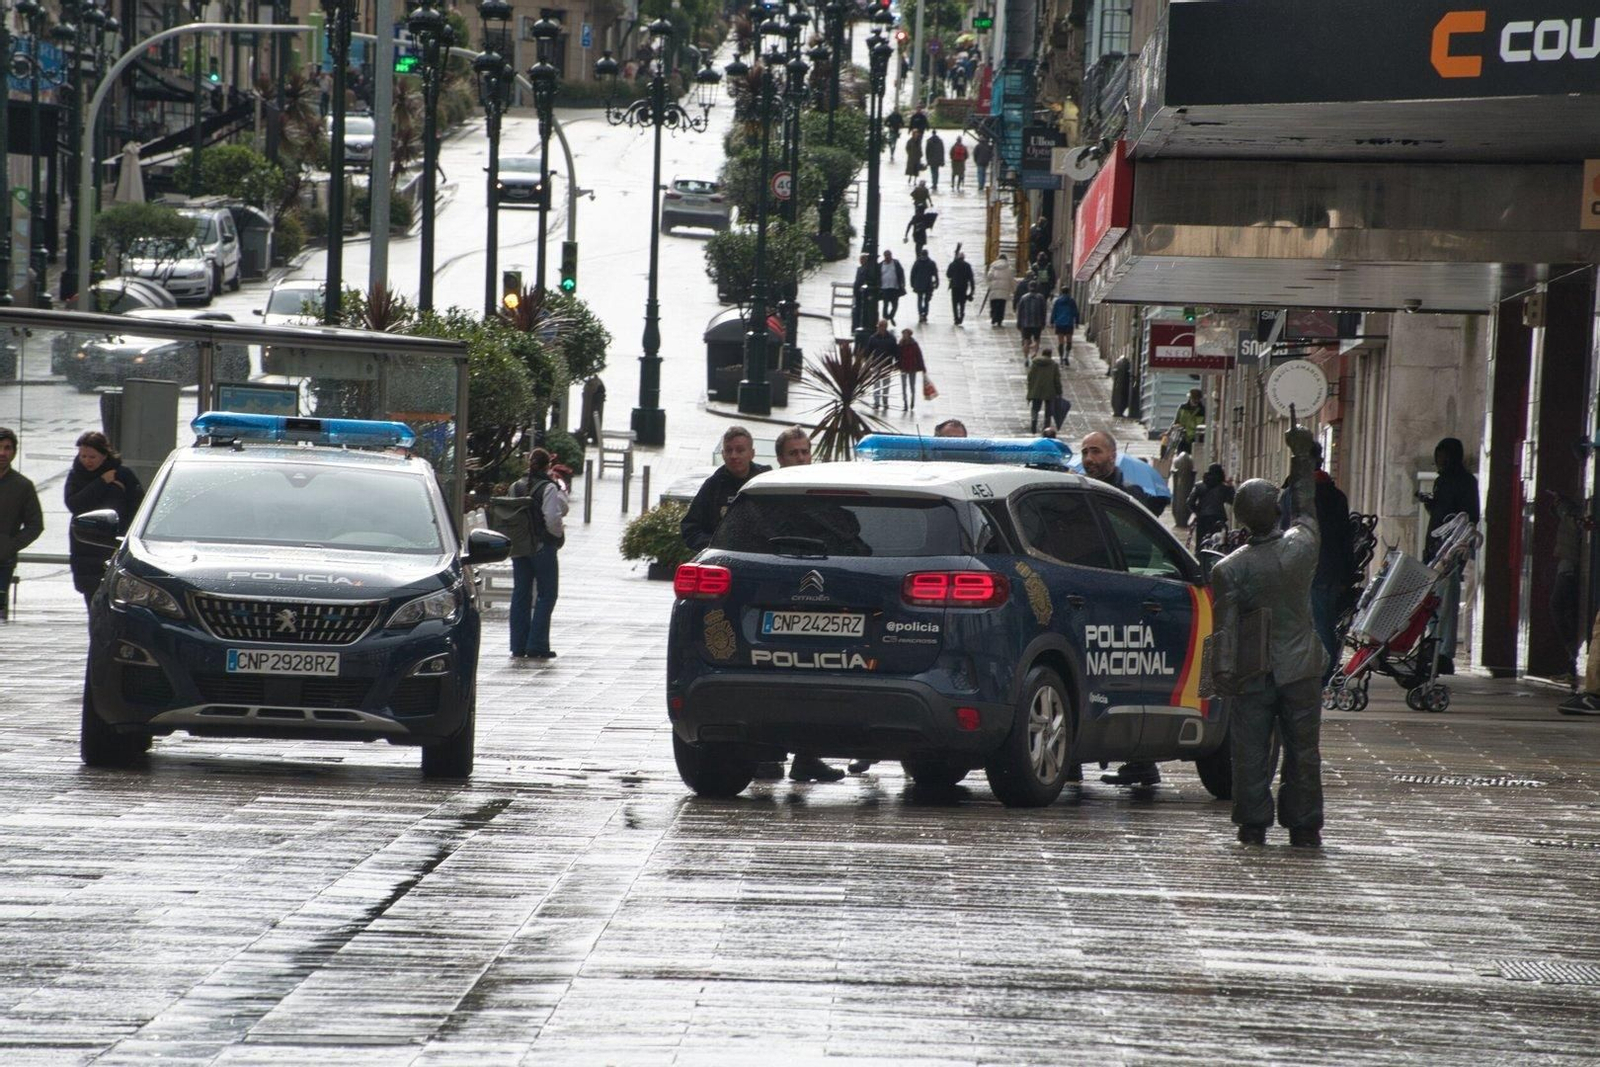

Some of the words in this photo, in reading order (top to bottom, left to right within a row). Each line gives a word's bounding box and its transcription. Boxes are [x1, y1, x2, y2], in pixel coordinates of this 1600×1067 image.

[1030, 136, 1056, 146] Ulloa
[971, 483, 994, 498] 4EJ
[773, 614, 862, 633] CNP2425RZ
[886, 621, 940, 633] @policia
[1085, 619, 1154, 648] POLICÍA
[237, 652, 337, 673] CNP2928RZ
[751, 649, 868, 669] POLICÍA
[1086, 651, 1174, 676] NACIONAL
